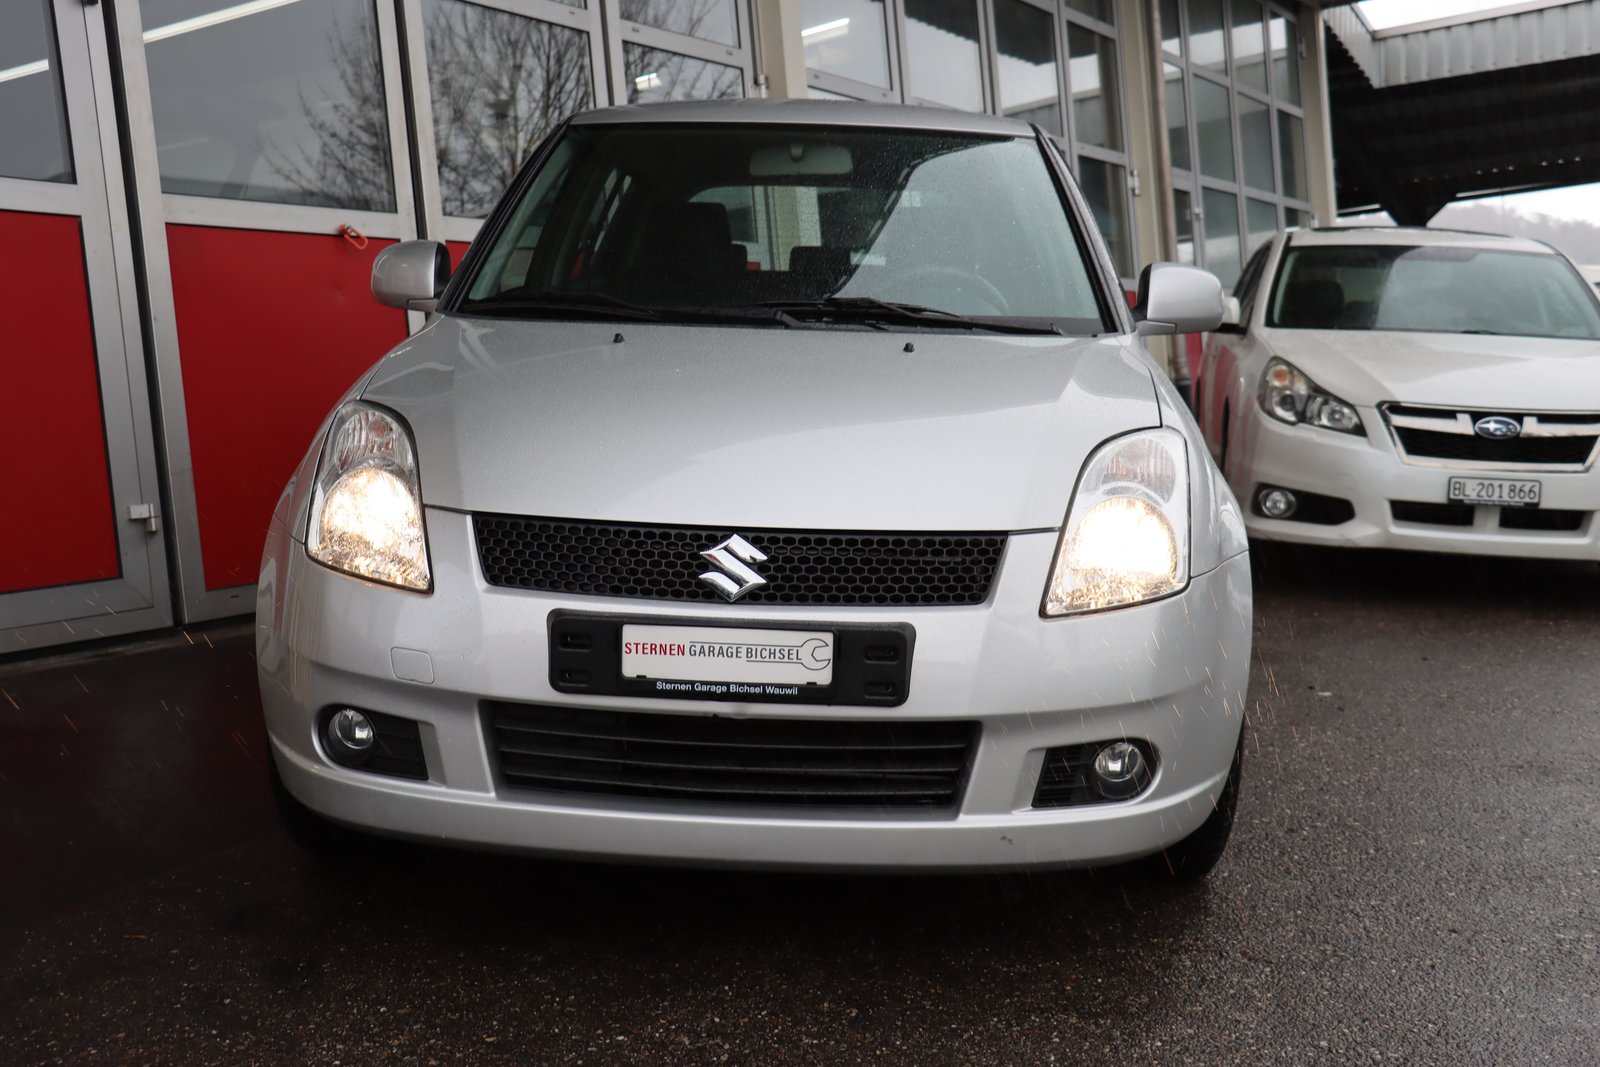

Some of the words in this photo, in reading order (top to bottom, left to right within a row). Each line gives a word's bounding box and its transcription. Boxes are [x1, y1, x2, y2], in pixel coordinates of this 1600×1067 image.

[624, 642, 686, 656] STERNEN
[689, 644, 742, 658] GARAGE
[745, 647, 802, 661] BICHSEL
[656, 681, 692, 691] Sternen
[694, 683, 727, 693] Garage
[729, 683, 763, 694] Bichsel
[765, 685, 798, 695] Wauwil
